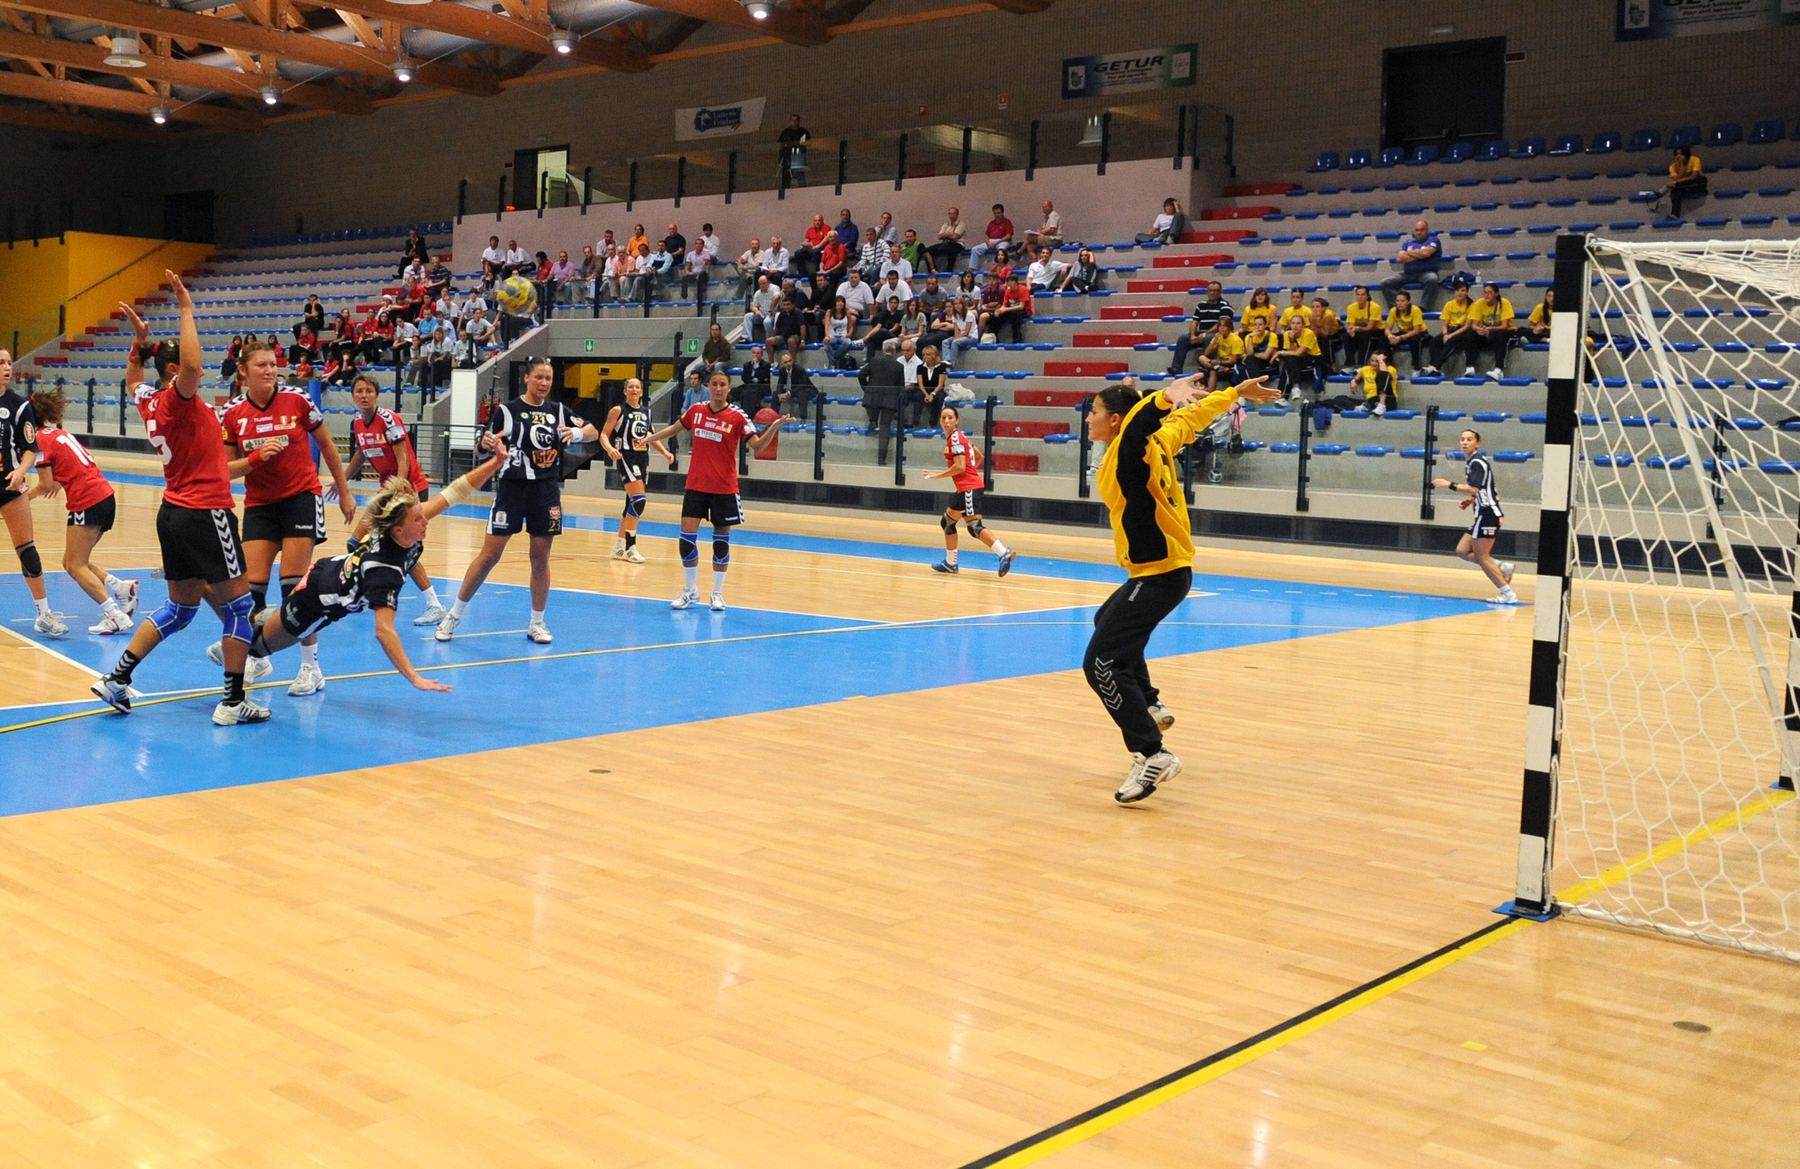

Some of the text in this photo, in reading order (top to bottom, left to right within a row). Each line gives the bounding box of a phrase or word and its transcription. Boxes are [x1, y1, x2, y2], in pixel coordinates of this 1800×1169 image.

[1094, 55, 1164, 73] GETUR
[237, 417, 249, 436] 7
[693, 412, 703, 425] 11
